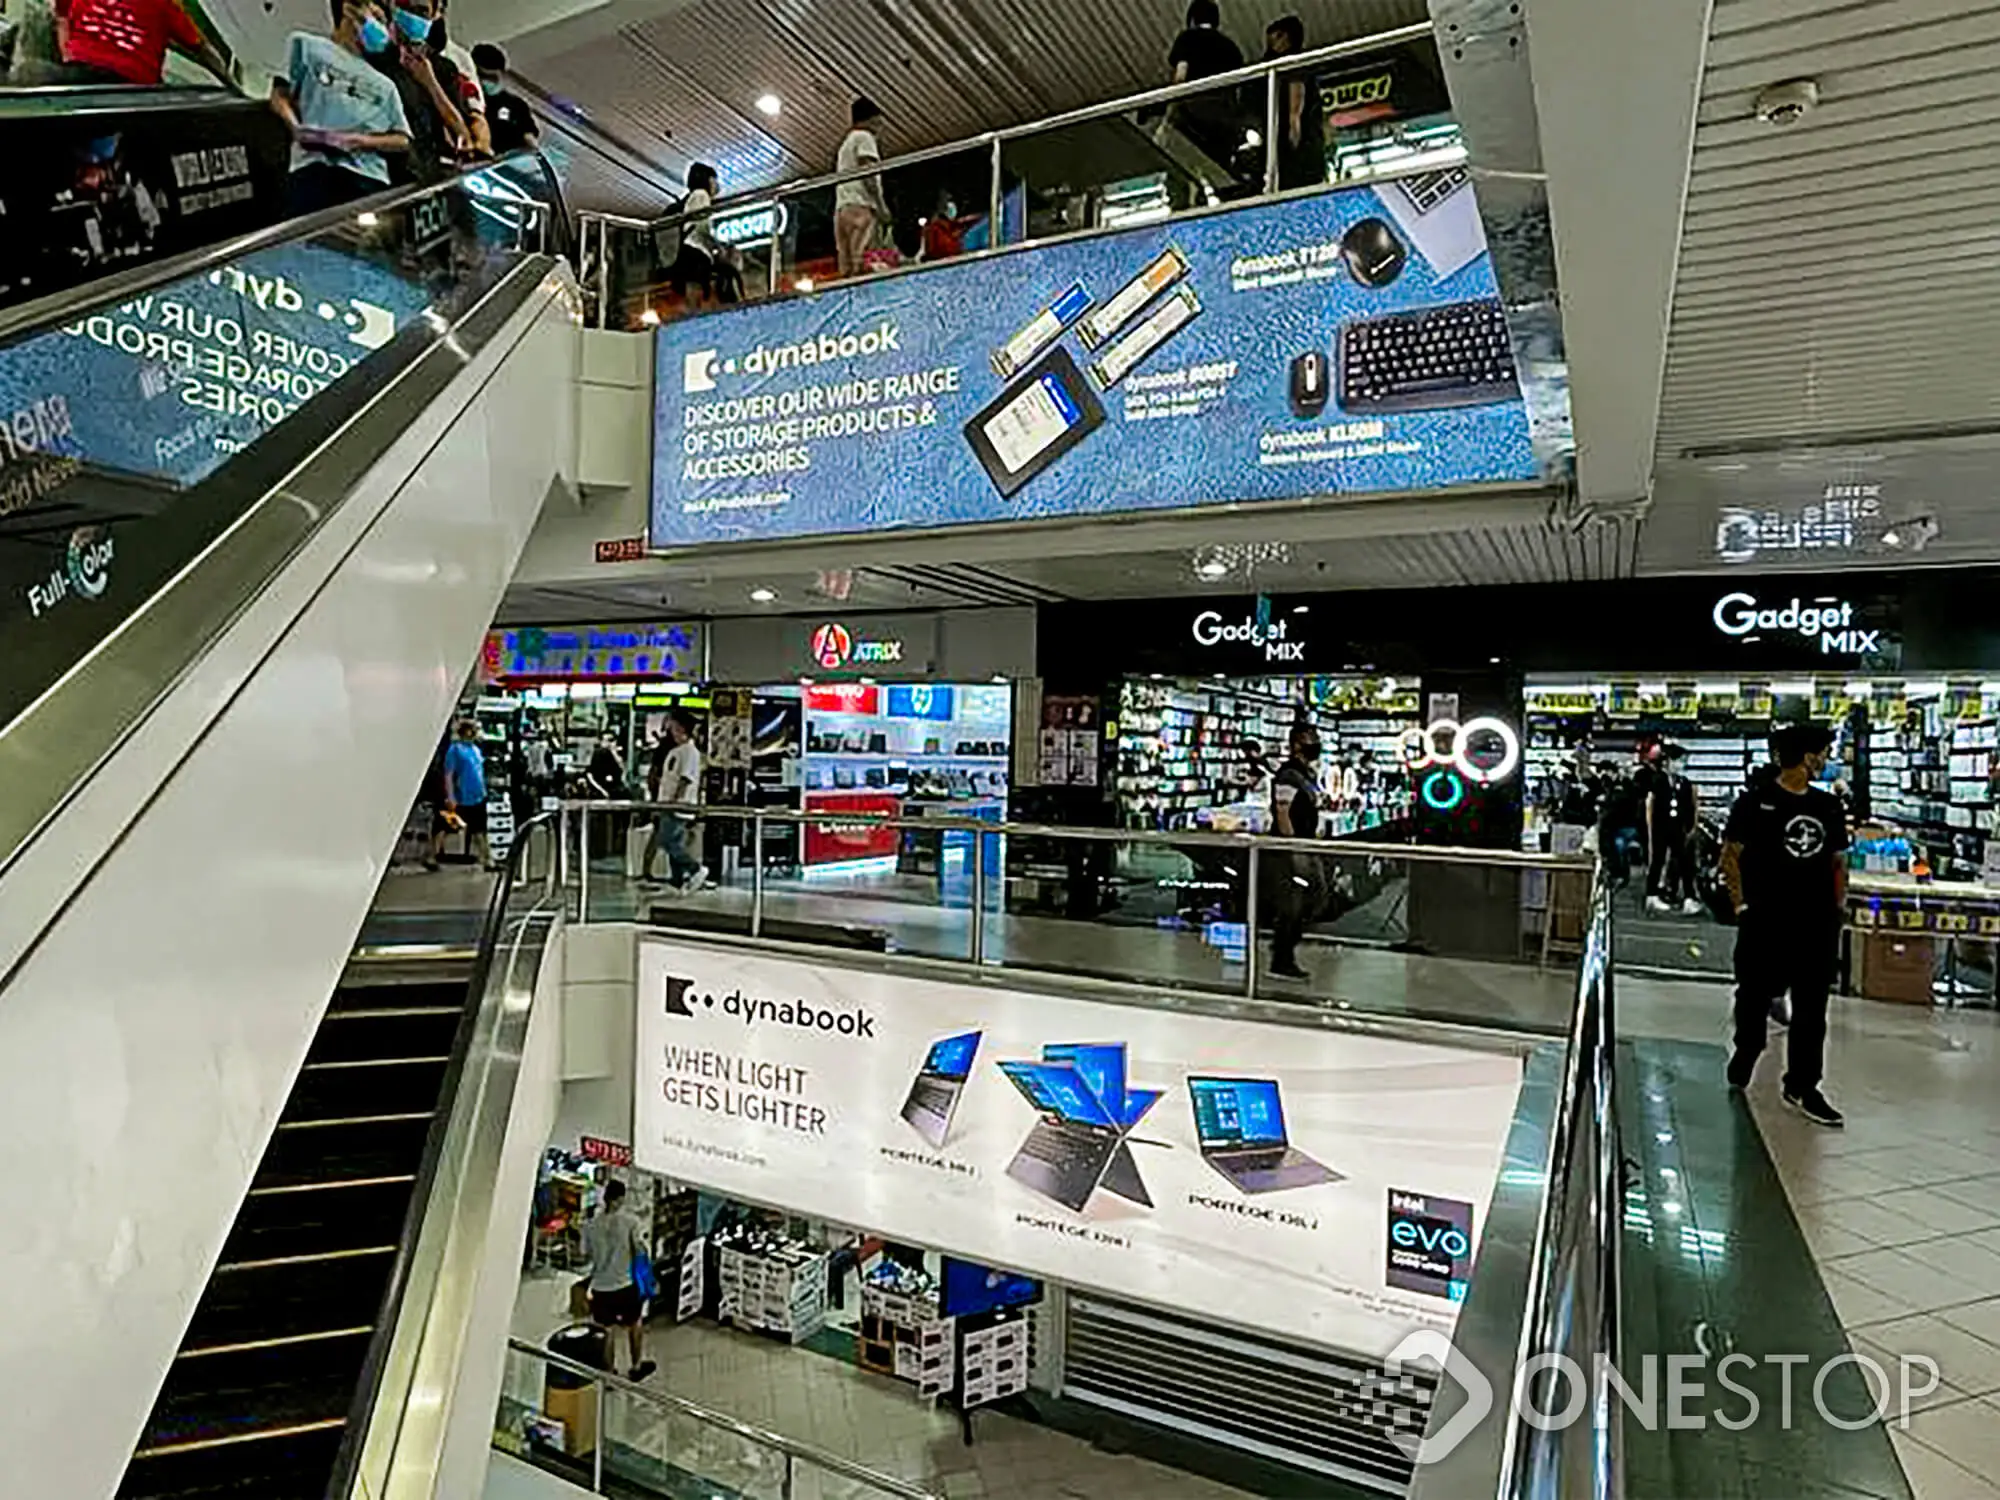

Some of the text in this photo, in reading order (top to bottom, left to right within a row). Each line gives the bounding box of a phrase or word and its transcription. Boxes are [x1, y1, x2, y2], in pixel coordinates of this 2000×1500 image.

[743, 322, 900, 378] dynabook
[684, 366, 960, 428] DISCOVER OUR WIDE RANGE
[683, 401, 938, 456] OF STORAGE PRODUCTS &
[683, 446, 811, 481] ACCESSORIES
[1192, 610, 1287, 646] Gadget
[1713, 592, 1852, 635] Gadget
[853, 642, 901, 662] ATRIX
[1265, 642, 1305, 661] MIX
[1821, 630, 1879, 653] MIX
[723, 989, 876, 1038] dynabook
[664, 1044, 808, 1096] WHEN LIGHT
[663, 1077, 827, 1136] GETS LIGHTER
[1392, 1220, 1468, 1257] evo
